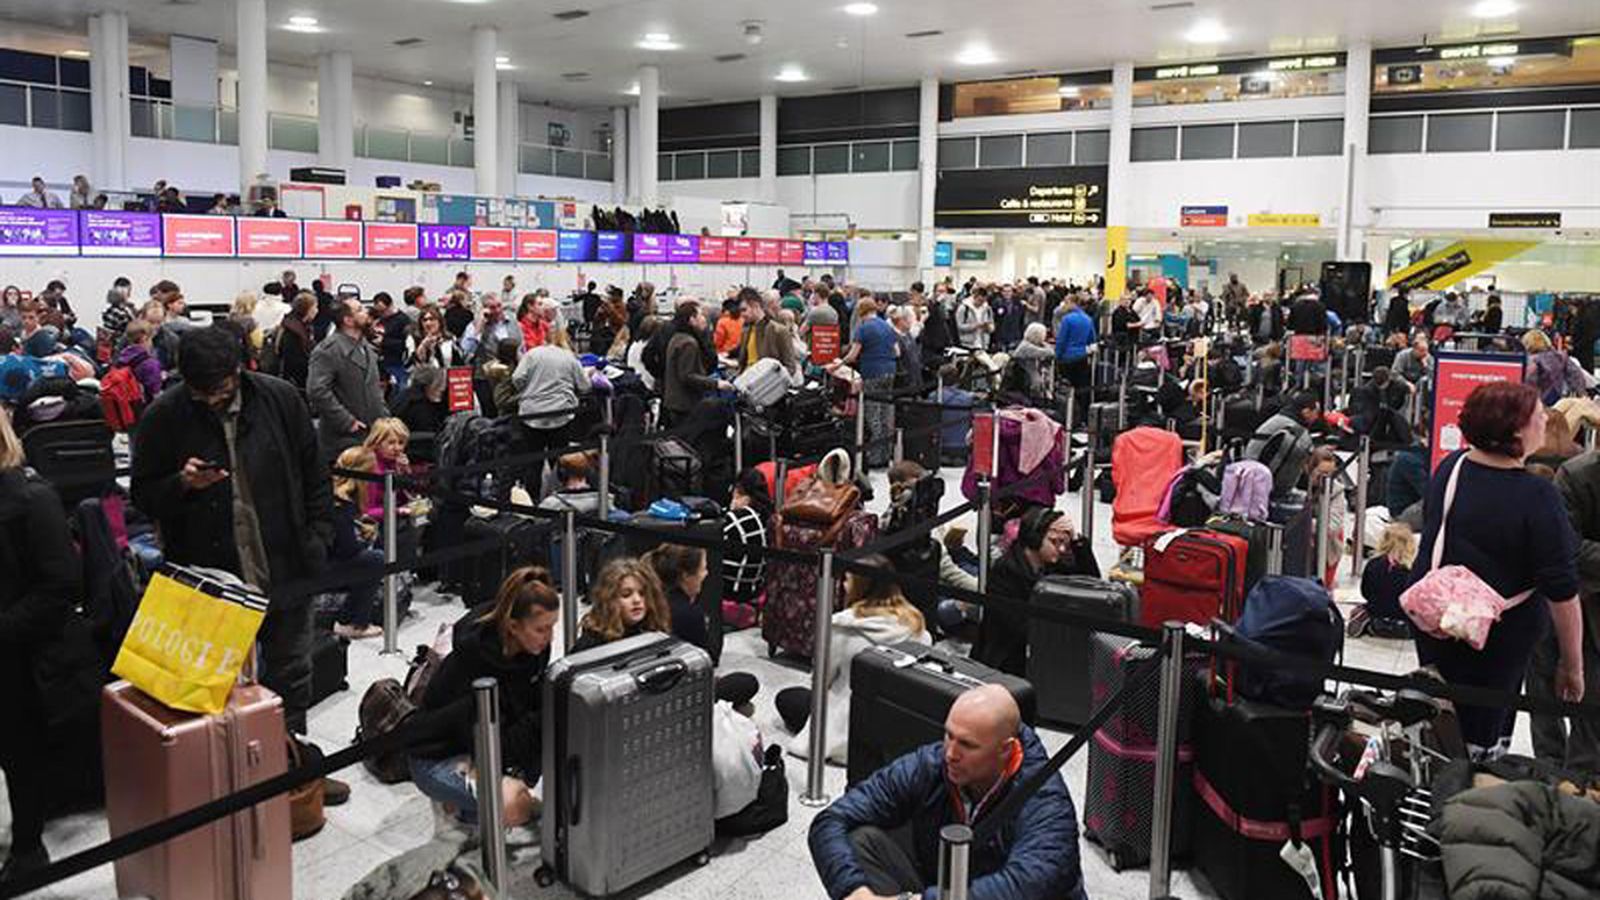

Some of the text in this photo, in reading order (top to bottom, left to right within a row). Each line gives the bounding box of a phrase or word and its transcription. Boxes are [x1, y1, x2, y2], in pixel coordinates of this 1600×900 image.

[1029, 185, 1073, 197] Departures
[1051, 212, 1073, 223] Hotel
[421, 230, 468, 249] 11:07
[1107, 249, 1117, 269] J
